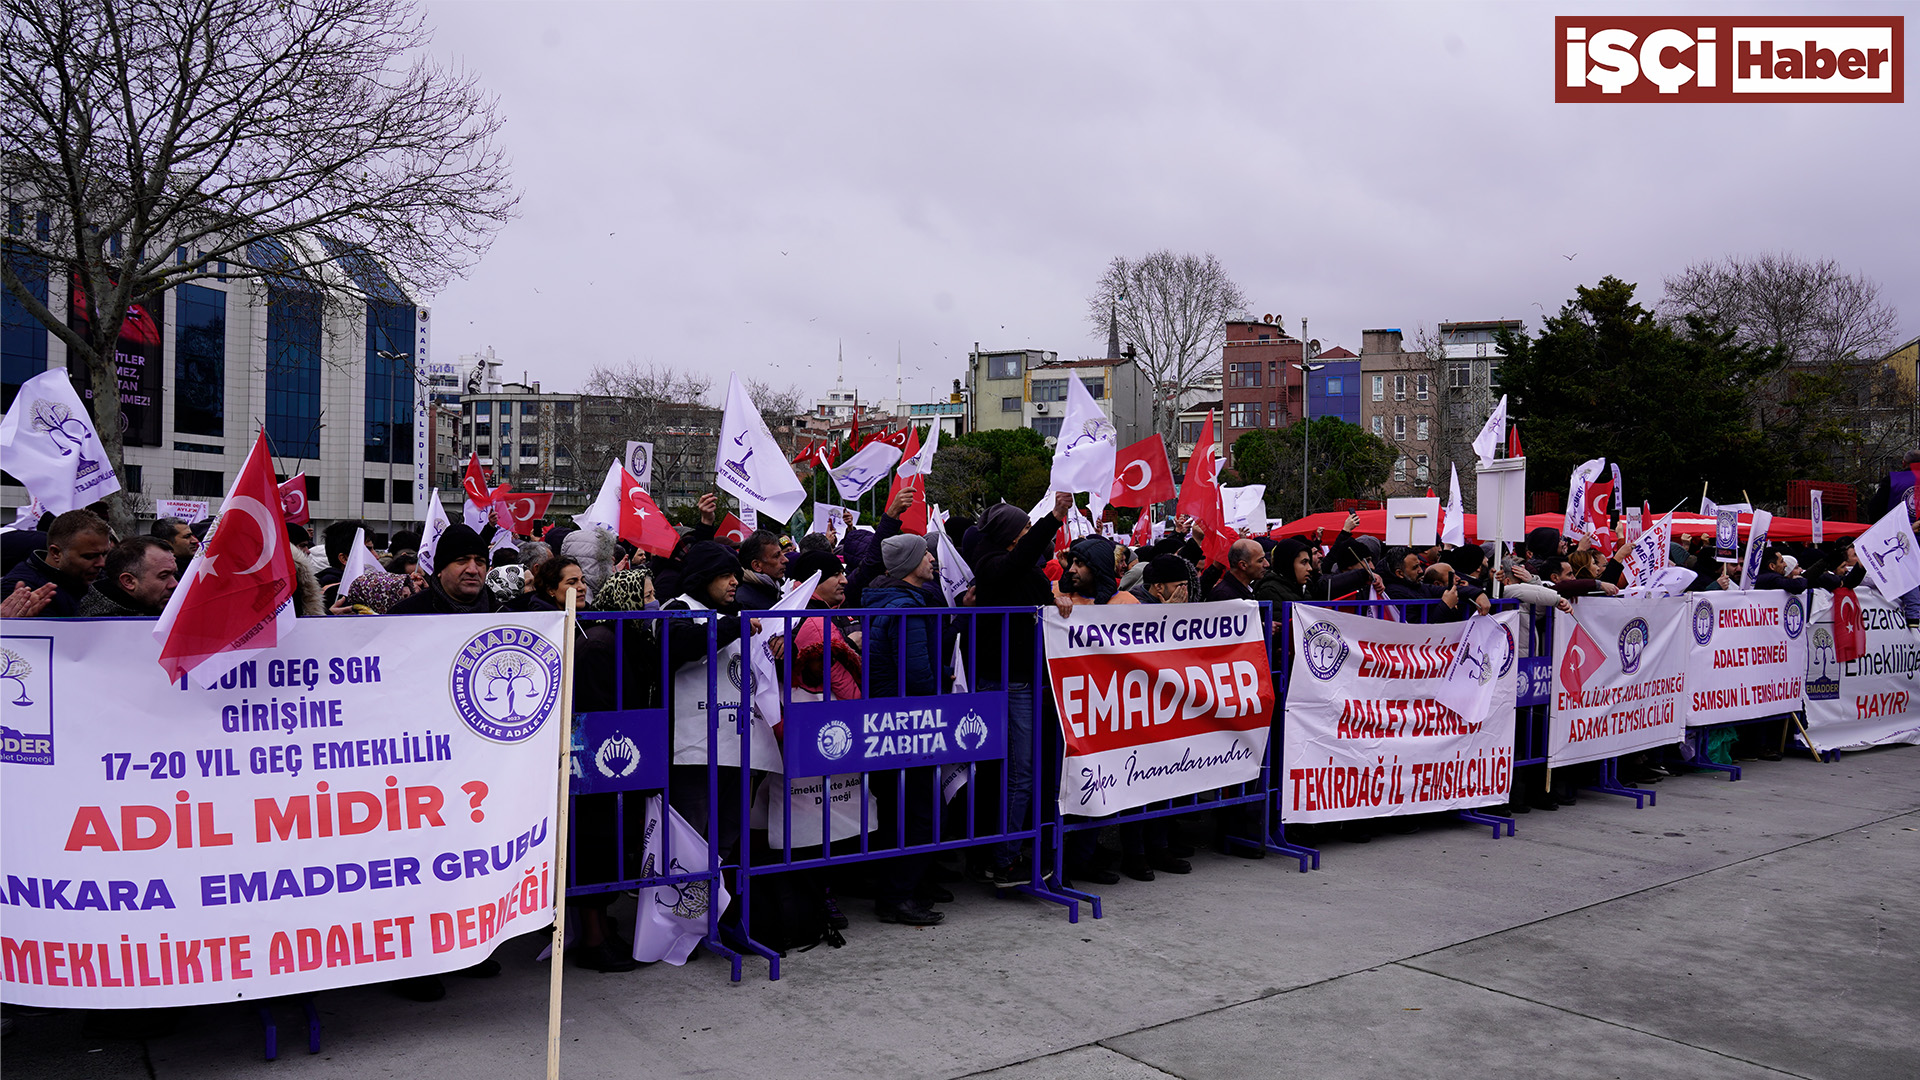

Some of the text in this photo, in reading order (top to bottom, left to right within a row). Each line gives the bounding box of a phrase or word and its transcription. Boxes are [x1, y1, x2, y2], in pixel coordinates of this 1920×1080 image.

[115, 350, 145, 366] İTLER
[725, 460, 749, 482] EMADDER
[1068, 614, 1248, 648] KAYSERİ GRUBU
[457, 629, 558, 671] EMADDER
[1358, 637, 1460, 679] EMEKLİLİK
[1713, 640, 1788, 669] ADALET DERNEĞİ
[268, 658, 320, 692] GEÇ
[329, 656, 382, 684] SGK
[1651, 672, 1685, 698] DERNEĞİ
[1806, 683, 1839, 694] EMADDER
[455, 676, 502, 737] EMEKLİLİKTE
[506, 713, 544, 738] ADALET
[1062, 660, 1263, 739] EMADDER
[1692, 676, 1802, 712] SAMSUN İL TEMSİLCİLİĞİ
[1856, 690, 1910, 720] HAYIR!
[222, 698, 344, 734] GİRİŞİNE
[863, 708, 948, 734] KARTAL
[1337, 699, 1483, 740] ADALET DERNE
[1568, 697, 1674, 743] ADANA TEMSİLCİLİĞİ
[199, 748, 241, 777] YIL
[249, 744, 300, 777] GEÇ
[313, 730, 452, 769] EMEKLİLİK
[864, 732, 948, 759] ZABITA
[1290, 746, 1512, 811] TEKİRDAĞ İL TEMSİLCİLİĞİ
[64, 775, 489, 853] ADİL MİDİR ?
[200, 856, 420, 907] EMADDER
[432, 816, 549, 882] GRUBU
[0, 860, 549, 988] MEKLİLİKTE ADALET DERNEĞİ
